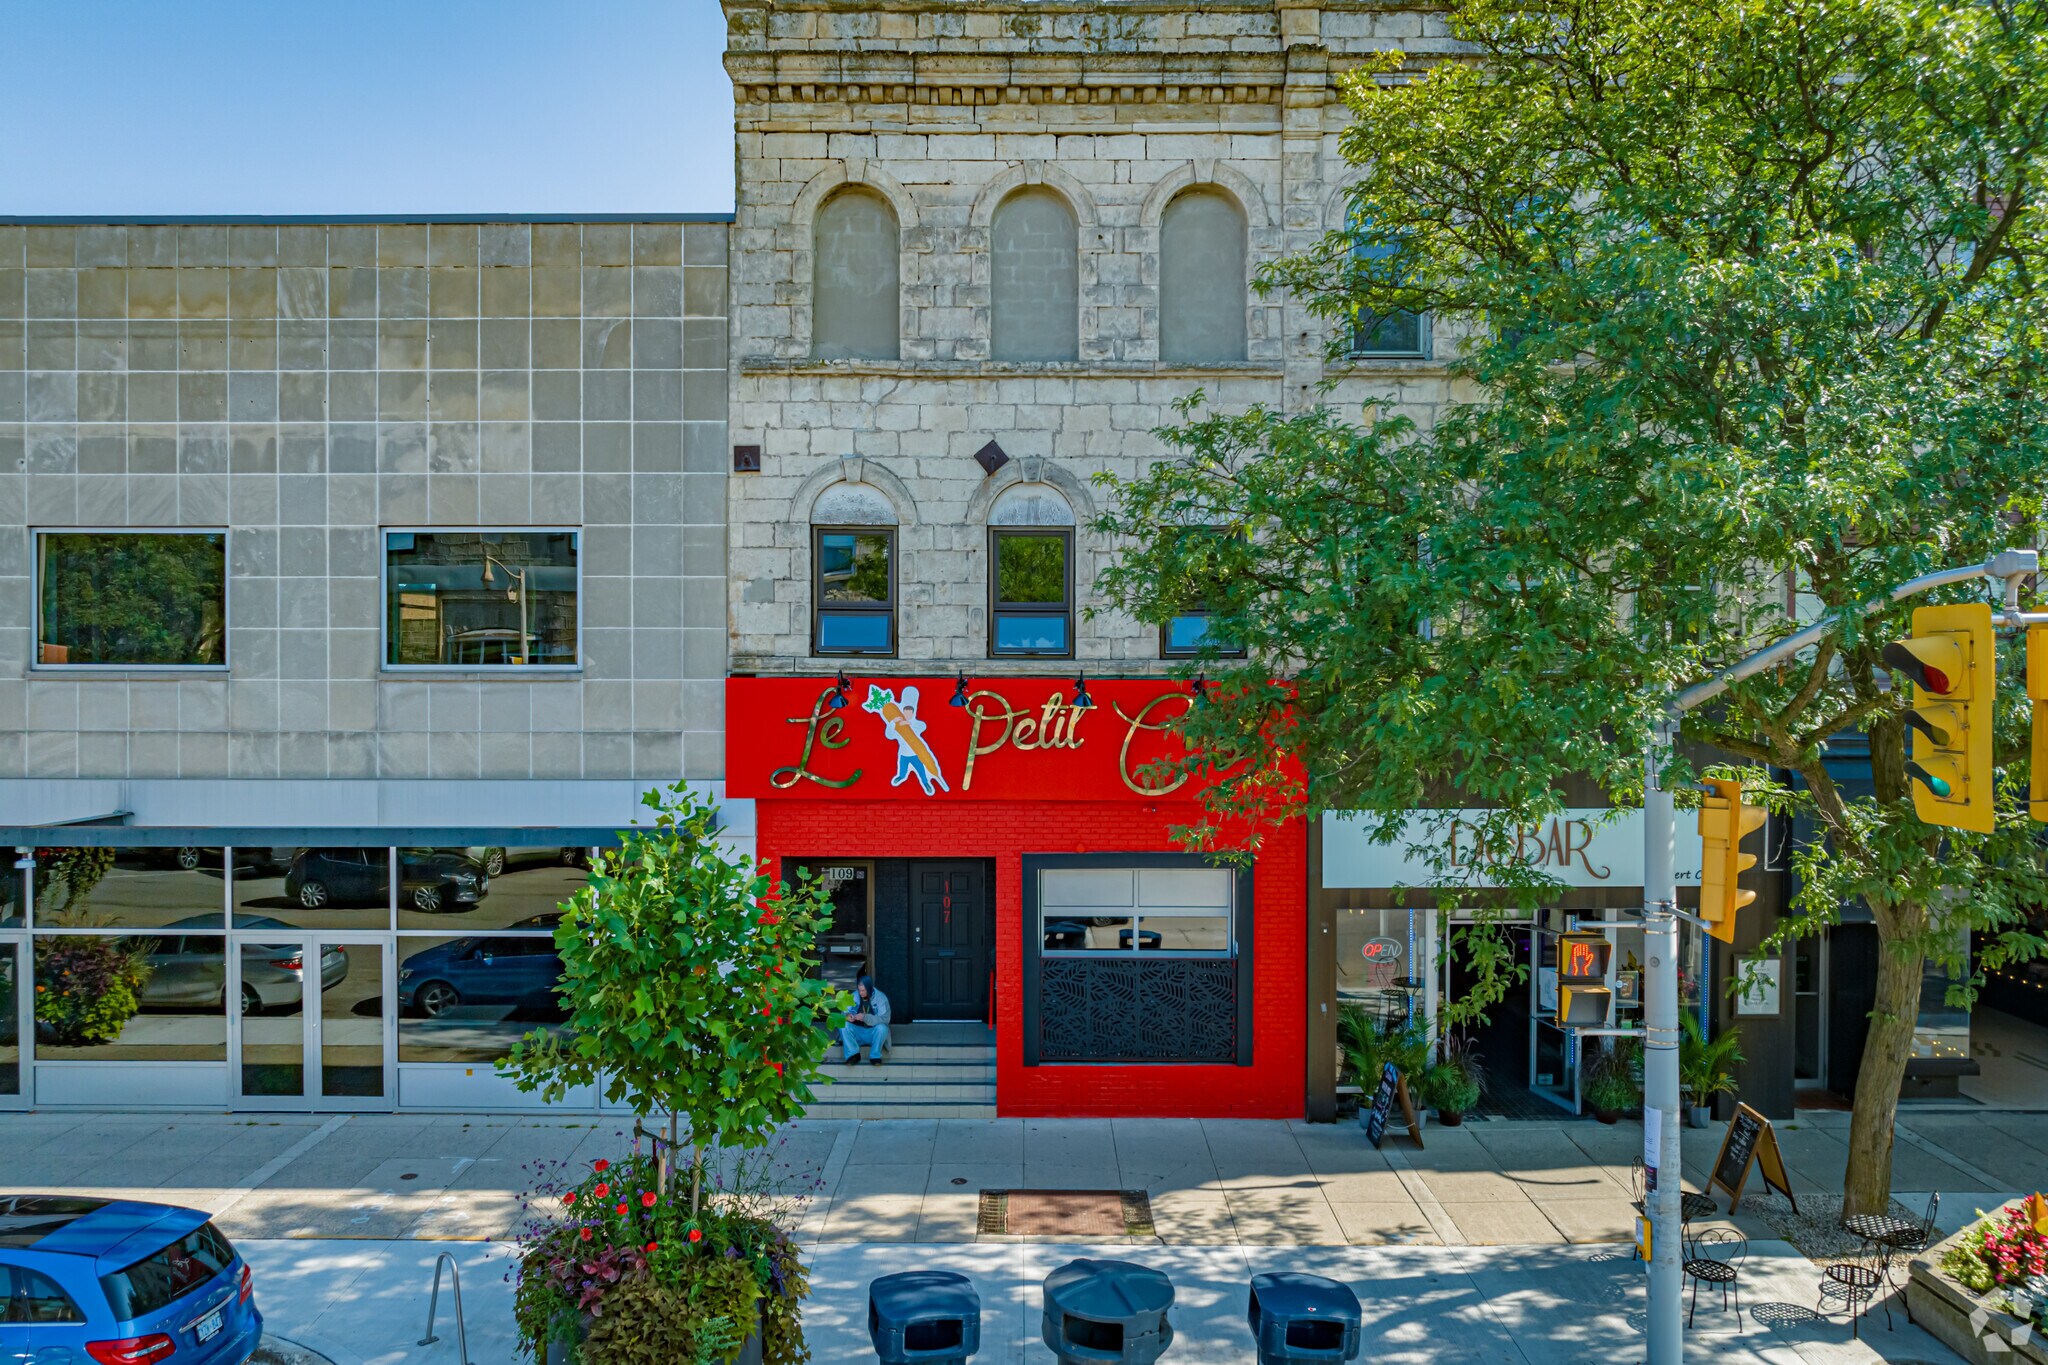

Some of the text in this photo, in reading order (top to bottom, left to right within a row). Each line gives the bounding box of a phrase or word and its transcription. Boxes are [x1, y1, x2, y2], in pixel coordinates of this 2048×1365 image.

[769, 686, 863, 789] Le
[962, 690, 1098, 791] Petit
[831, 868, 854, 880] 109
[943, 880, 951, 924] 107
[1363, 942, 1400, 957] OPEN
